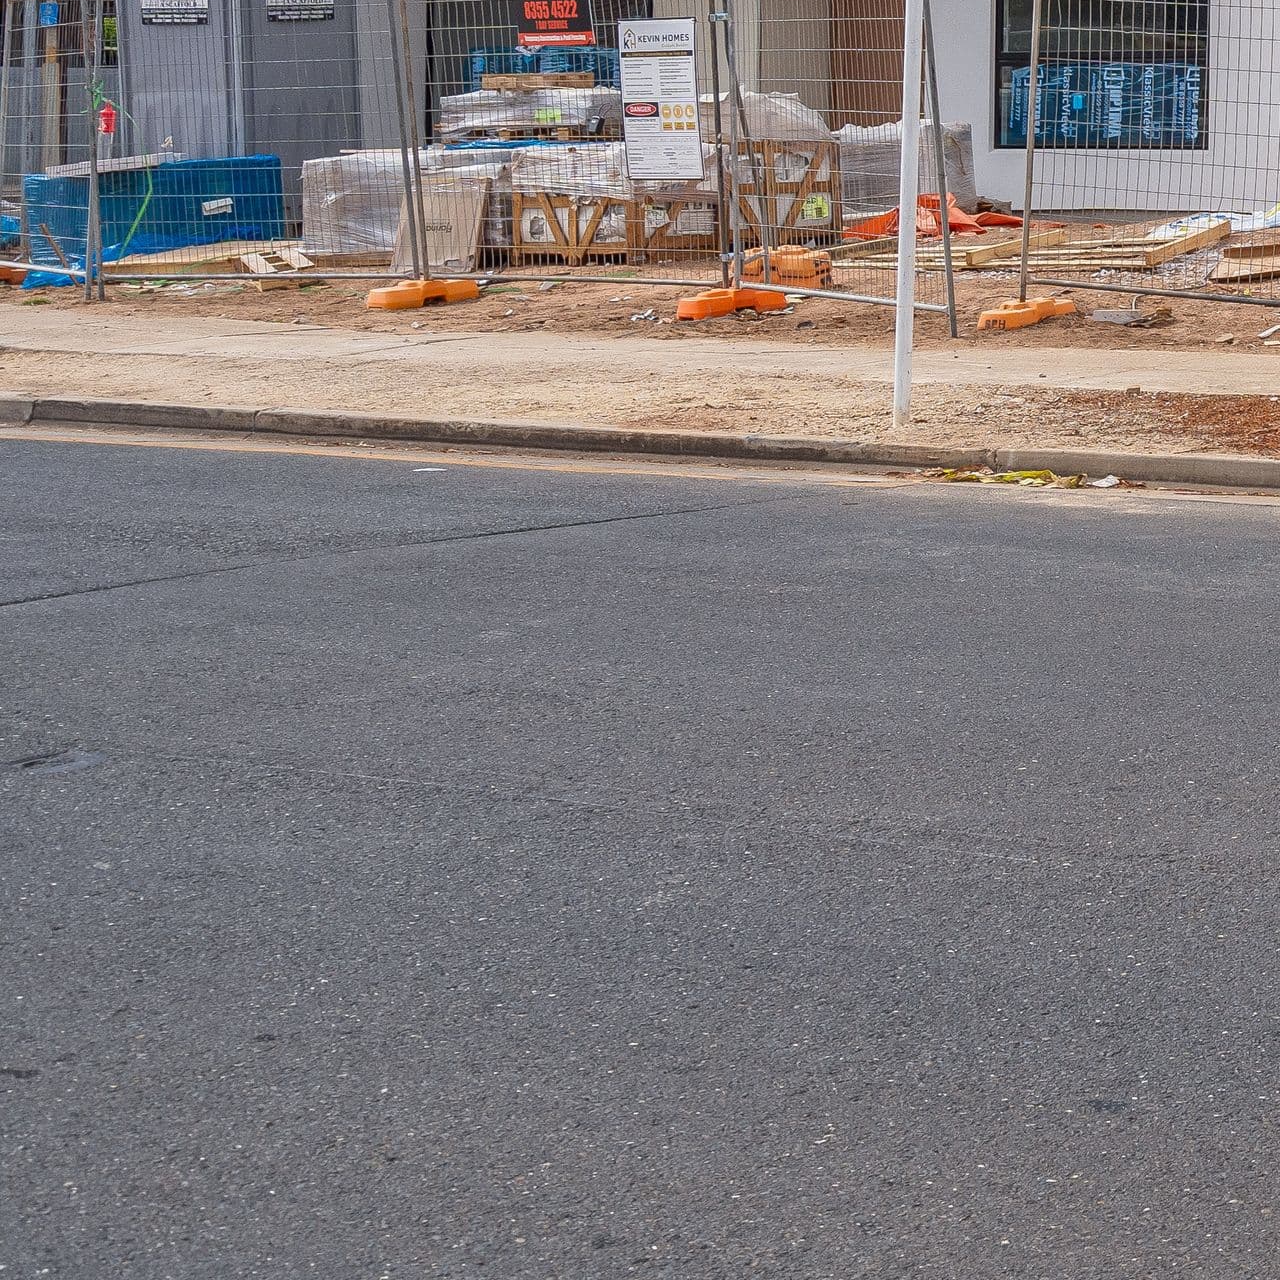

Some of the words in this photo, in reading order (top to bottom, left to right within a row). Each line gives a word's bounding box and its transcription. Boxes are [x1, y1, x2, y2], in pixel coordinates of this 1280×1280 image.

[523, 1, 550, 20] 8355
[551, 0, 578, 19] 4522
[637, 34, 660, 43] KEVIN
[662, 33, 690, 42] HOMES
[1061, 66, 1073, 134] KlassicView
[1108, 89, 1122, 138] OPTIMA
[1142, 66, 1154, 136] KlassicView
